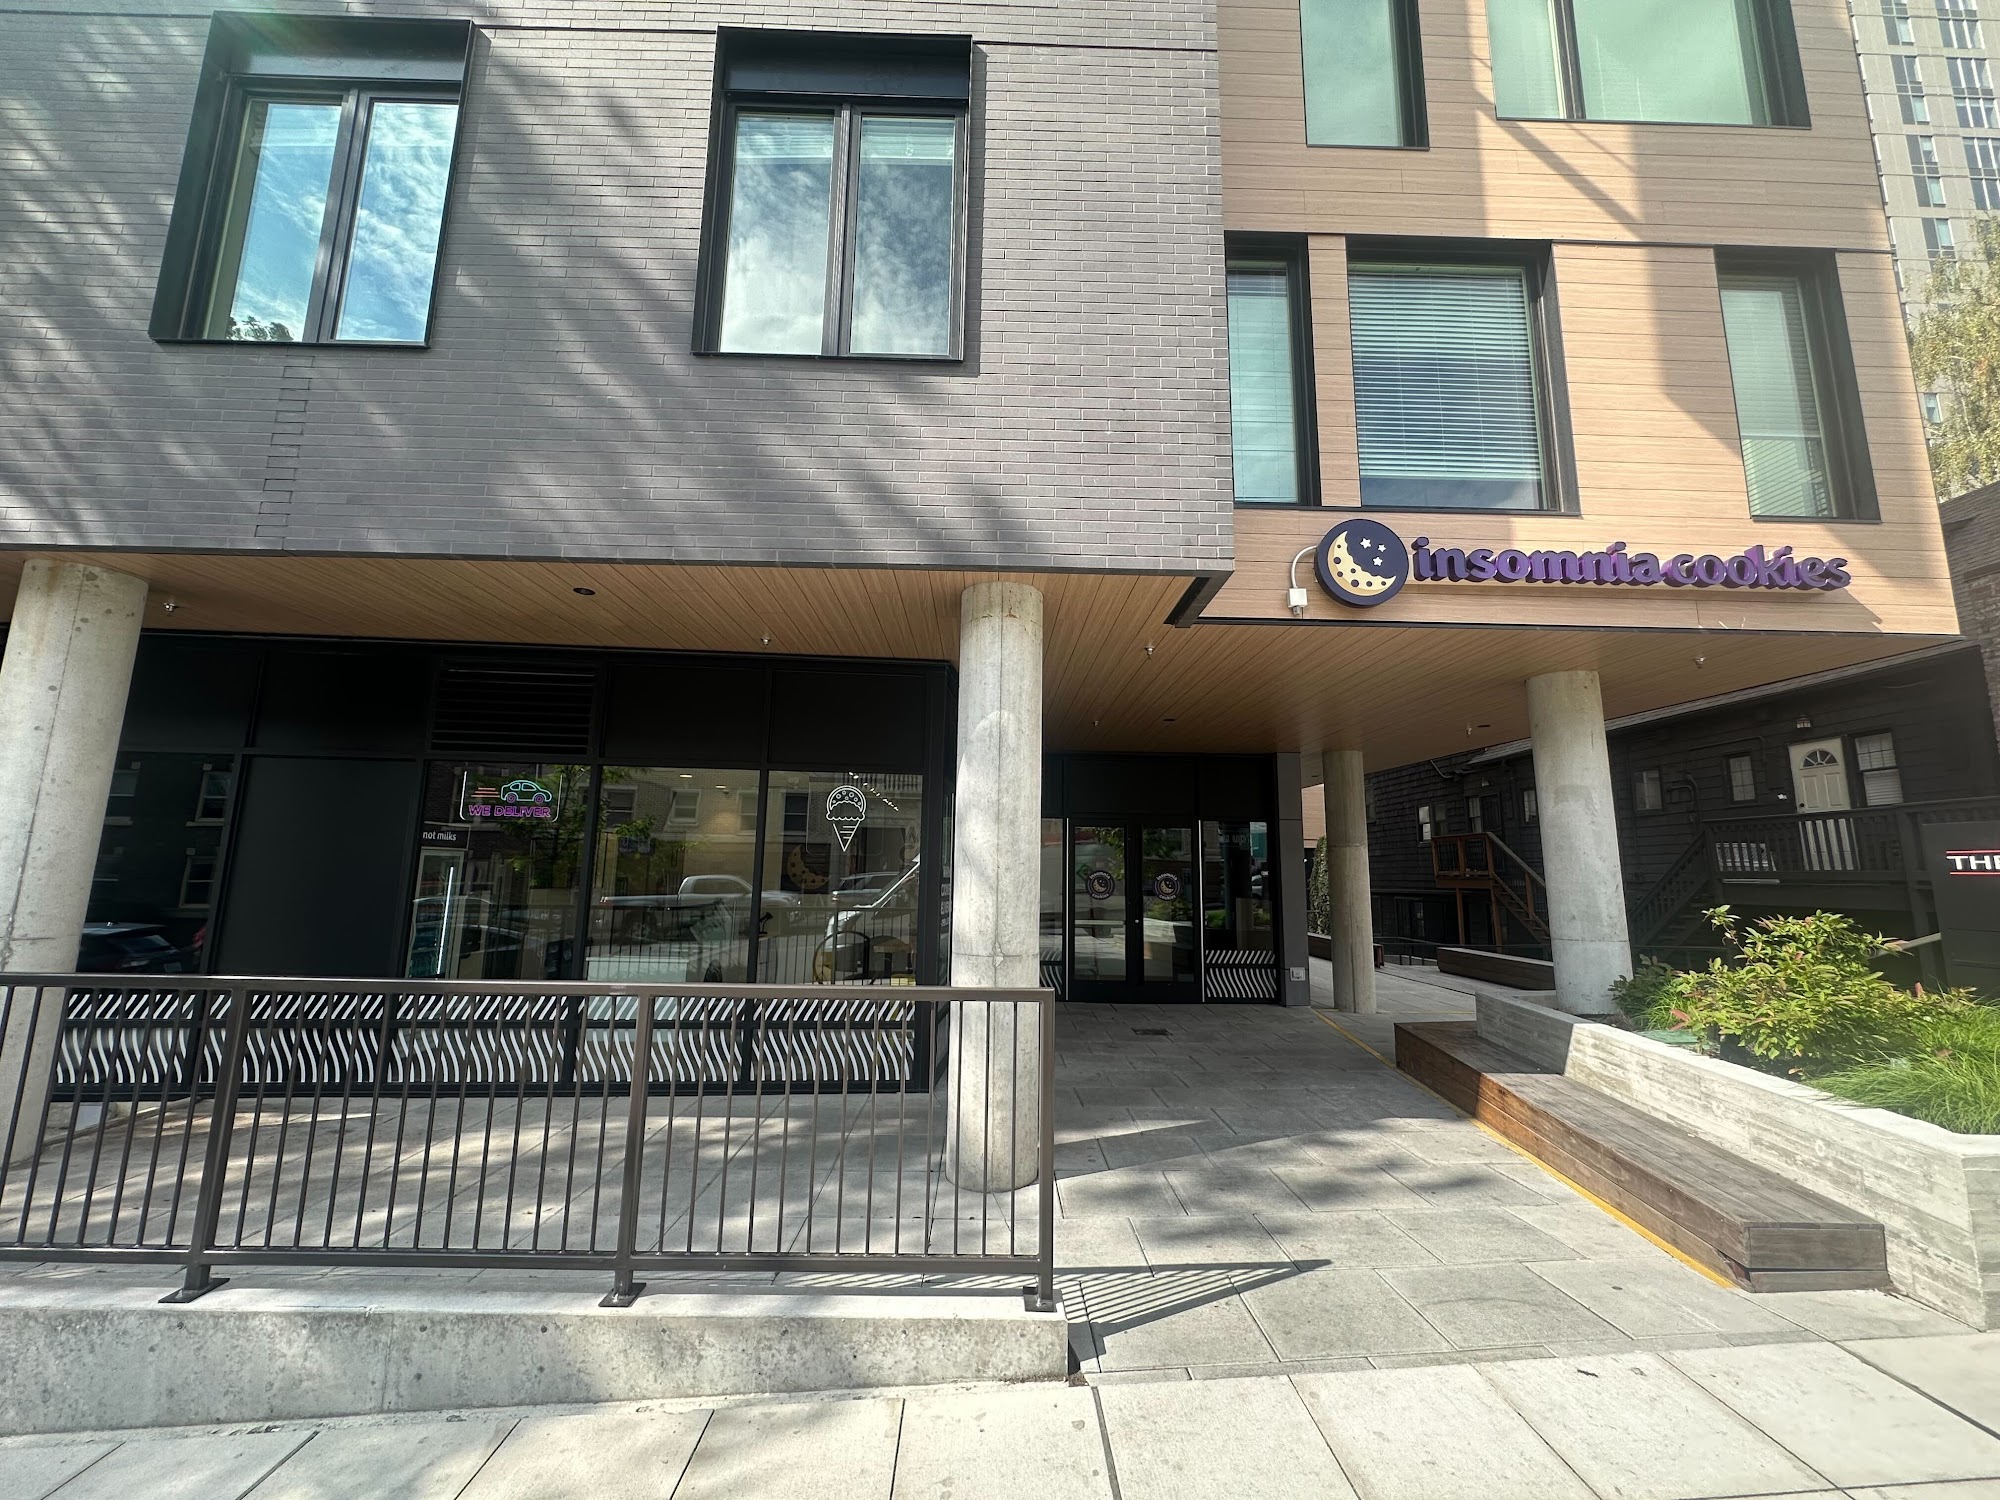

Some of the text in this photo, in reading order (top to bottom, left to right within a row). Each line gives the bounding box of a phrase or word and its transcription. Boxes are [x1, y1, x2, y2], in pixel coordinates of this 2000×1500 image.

[1412, 536, 1851, 592] insomnia cookies
[468, 804, 551, 818] WE DELIVER
[422, 830, 457, 841] not milks
